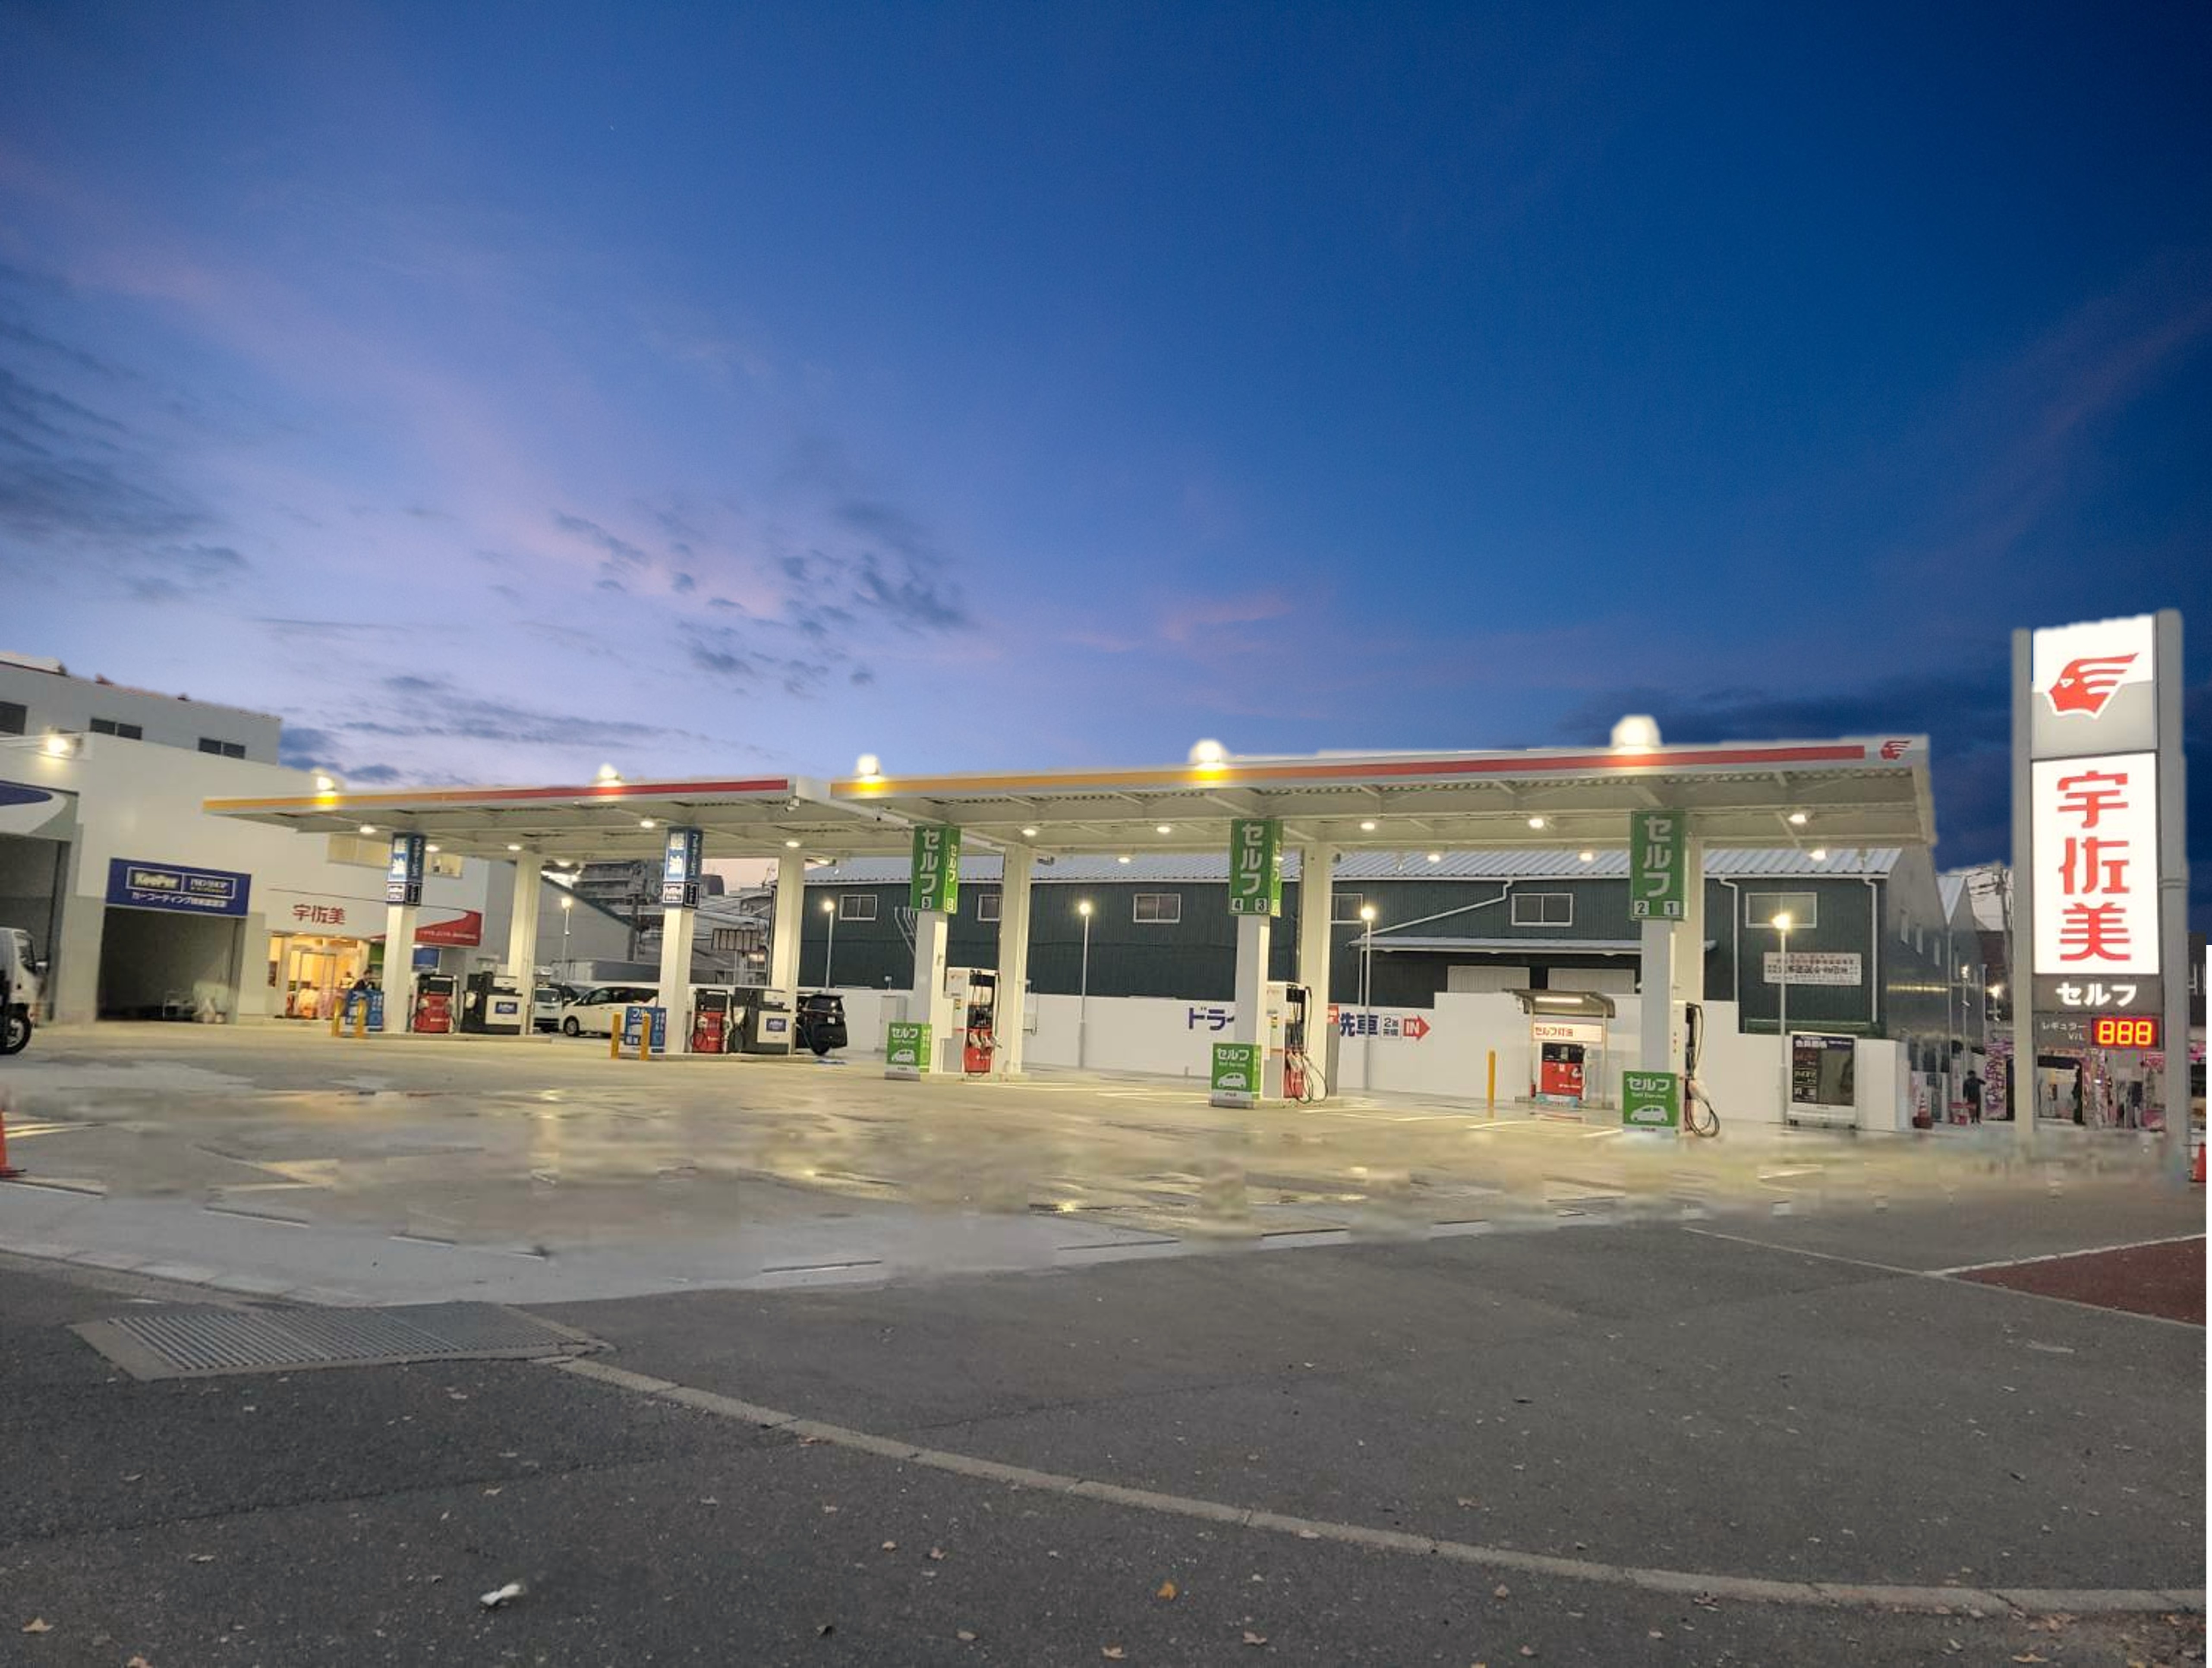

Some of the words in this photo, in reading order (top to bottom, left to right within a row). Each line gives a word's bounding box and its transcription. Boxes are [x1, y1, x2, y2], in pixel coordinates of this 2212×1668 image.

[920, 829, 940, 894] セルフ
[1240, 823, 1264, 895] セルフ
[1643, 815, 1672, 897] セルフ
[2057, 771, 2131, 961] 宇佐美
[293, 904, 346, 924] 宇佐美
[1638, 902, 1645, 914] 2
[1667, 902, 1674, 914] 1
[2055, 982, 2136, 1007] セルフ
[891, 1028, 918, 1038] セルフ
[1406, 1021, 1420, 1034] IN
[2098, 1021, 2152, 1045] 888
[1217, 1048, 1249, 1061] セルフ
[1626, 1077, 1670, 1091] セルフ
